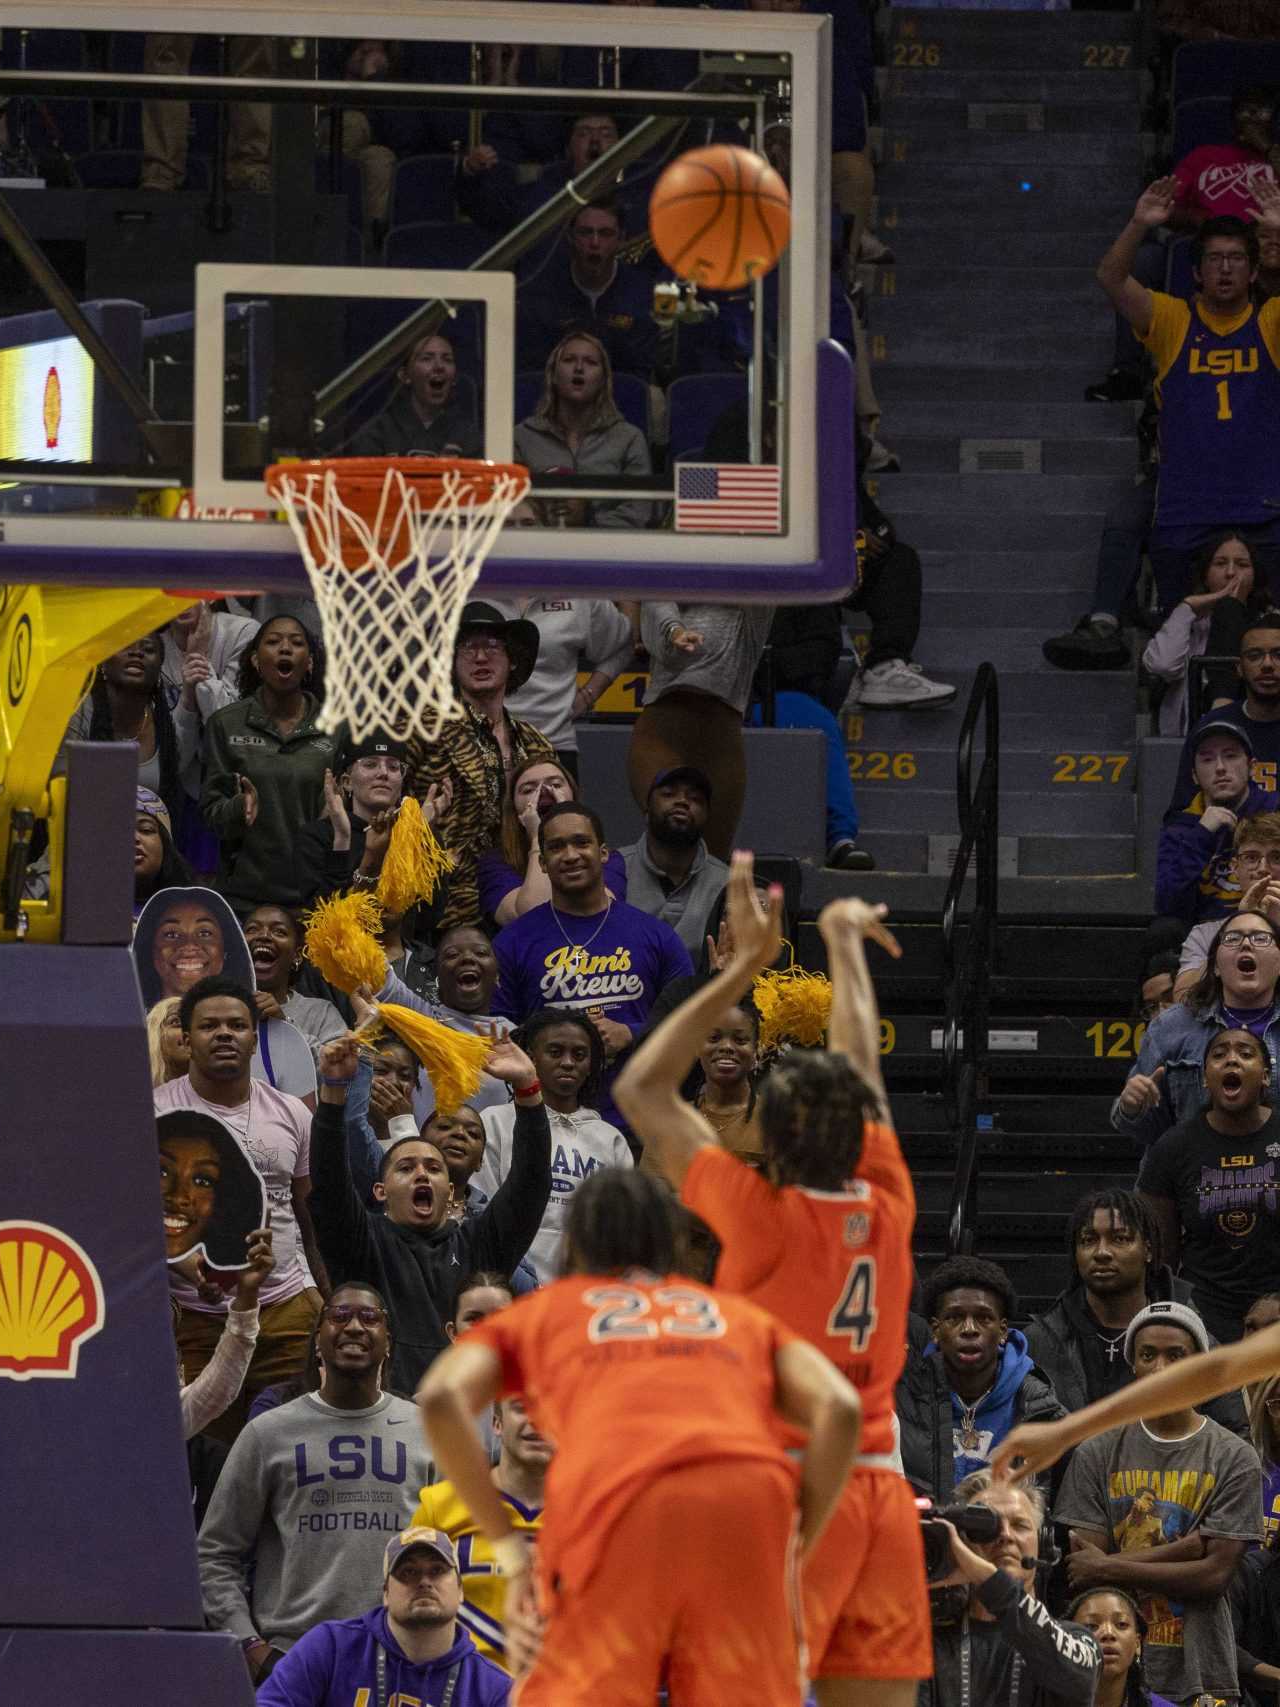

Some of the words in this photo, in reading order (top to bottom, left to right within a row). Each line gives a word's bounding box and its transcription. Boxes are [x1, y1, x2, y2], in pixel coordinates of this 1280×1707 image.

[1188, 347, 1259, 375] LSU
[1215, 380, 1232, 420] 1
[542, 601, 573, 612] LSU
[847, 752, 917, 781] 226
[1052, 754, 1129, 783] 227
[544, 945, 632, 976] Kim's
[540, 972, 644, 1001] Krewe
[1220, 1154, 1255, 1169] LSU
[582, 1284, 728, 1345] 23
[826, 1254, 878, 1353] 4
[295, 1434, 407, 1489] LSU
[298, 1511, 405, 1534] FOOTBALL
